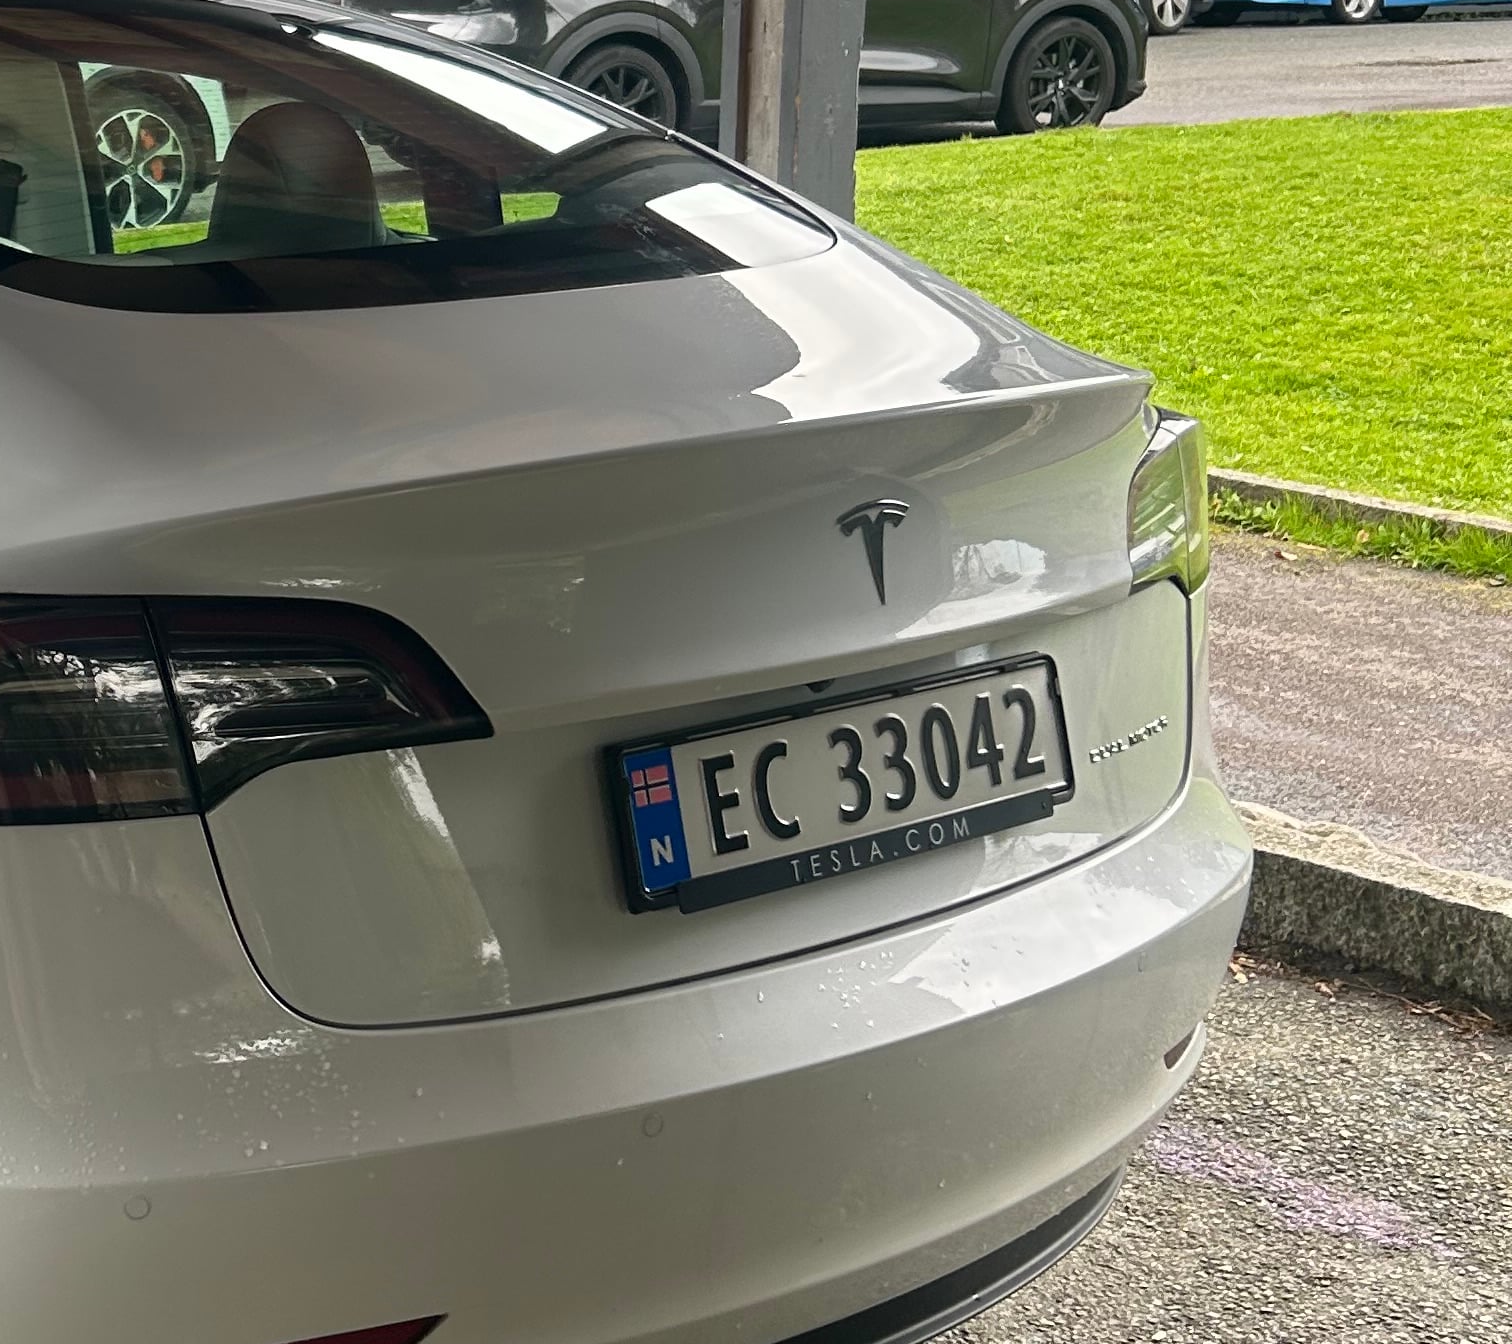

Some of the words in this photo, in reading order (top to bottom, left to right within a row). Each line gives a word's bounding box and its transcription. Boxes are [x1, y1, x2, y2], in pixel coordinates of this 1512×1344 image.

[698, 738, 803, 856] EC
[826, 683, 1048, 824] 33042
[649, 834, 675, 867] N
[790, 816, 971, 883] TESLA.COM
